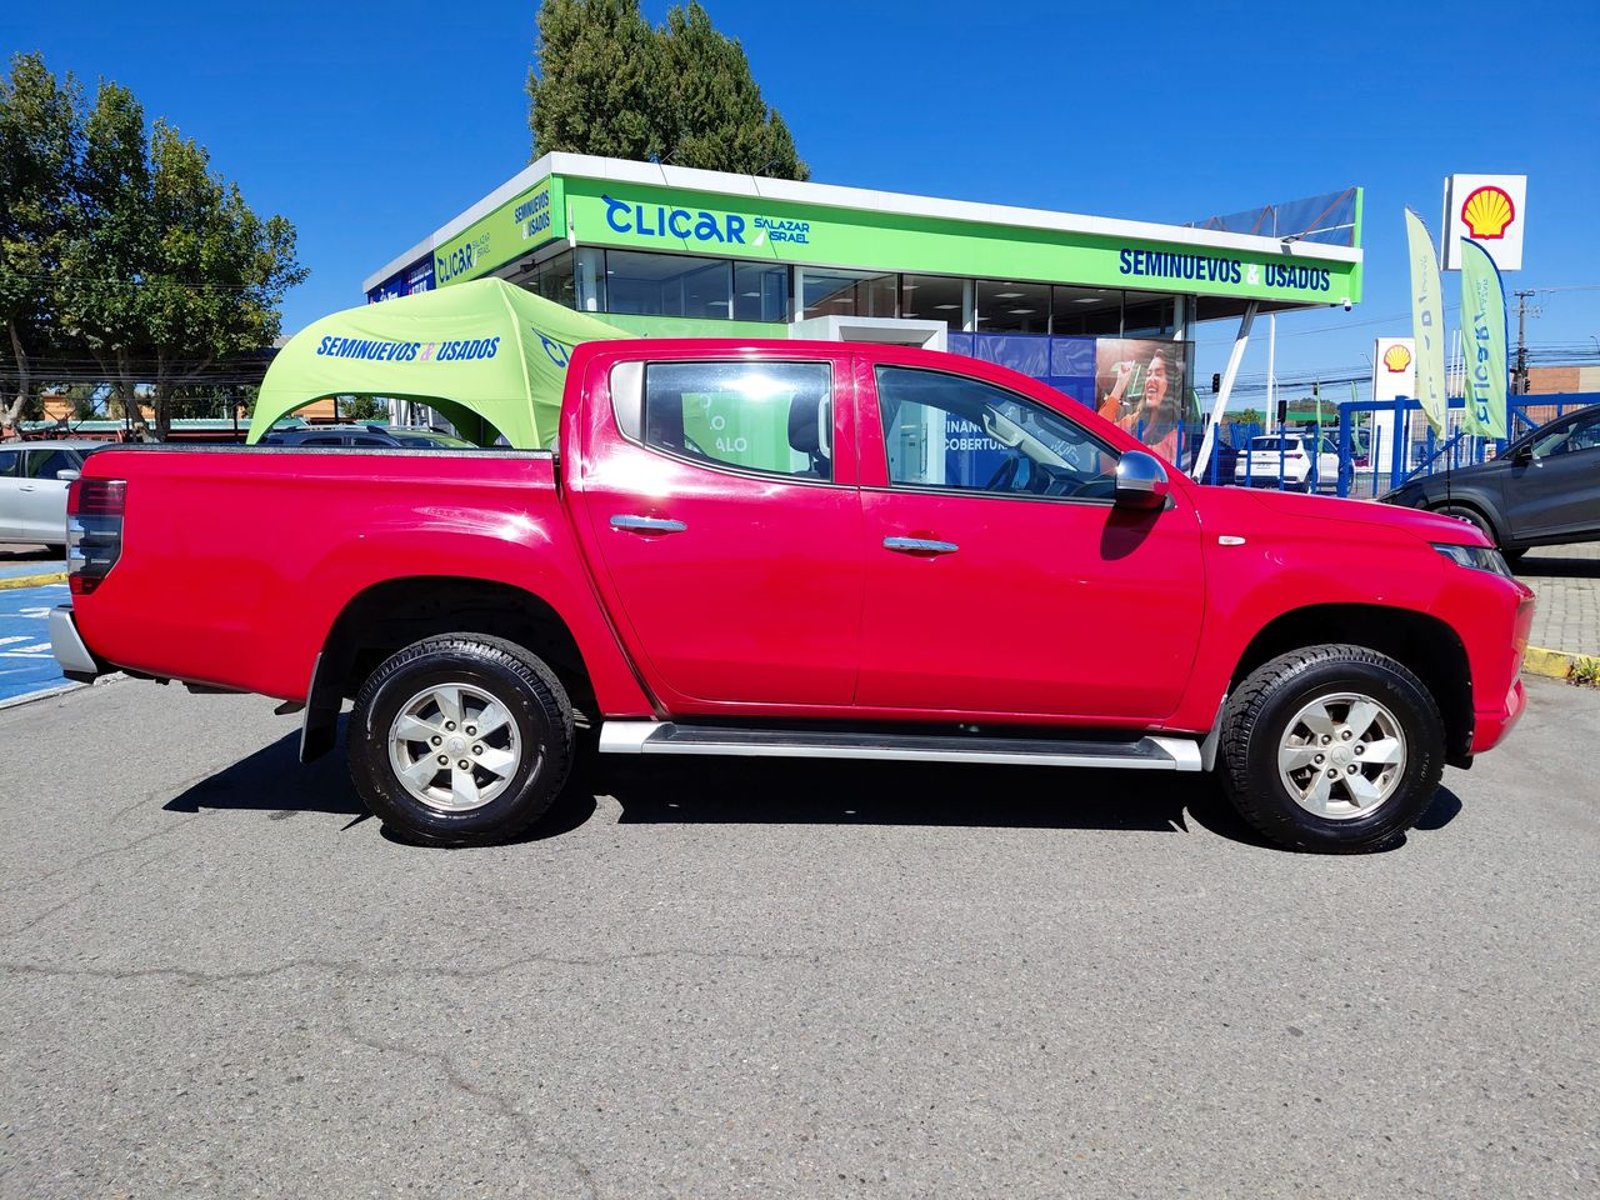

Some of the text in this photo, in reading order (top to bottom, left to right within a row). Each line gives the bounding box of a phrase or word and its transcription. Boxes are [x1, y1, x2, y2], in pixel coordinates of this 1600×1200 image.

[754, 217, 810, 233] SALAZAR
[769, 231, 810, 244] ISRAEL
[1119, 248, 1330, 291] SEMINUEVOS & USADOS
[317, 335, 500, 361] SEMINUEVOS & USADOS
